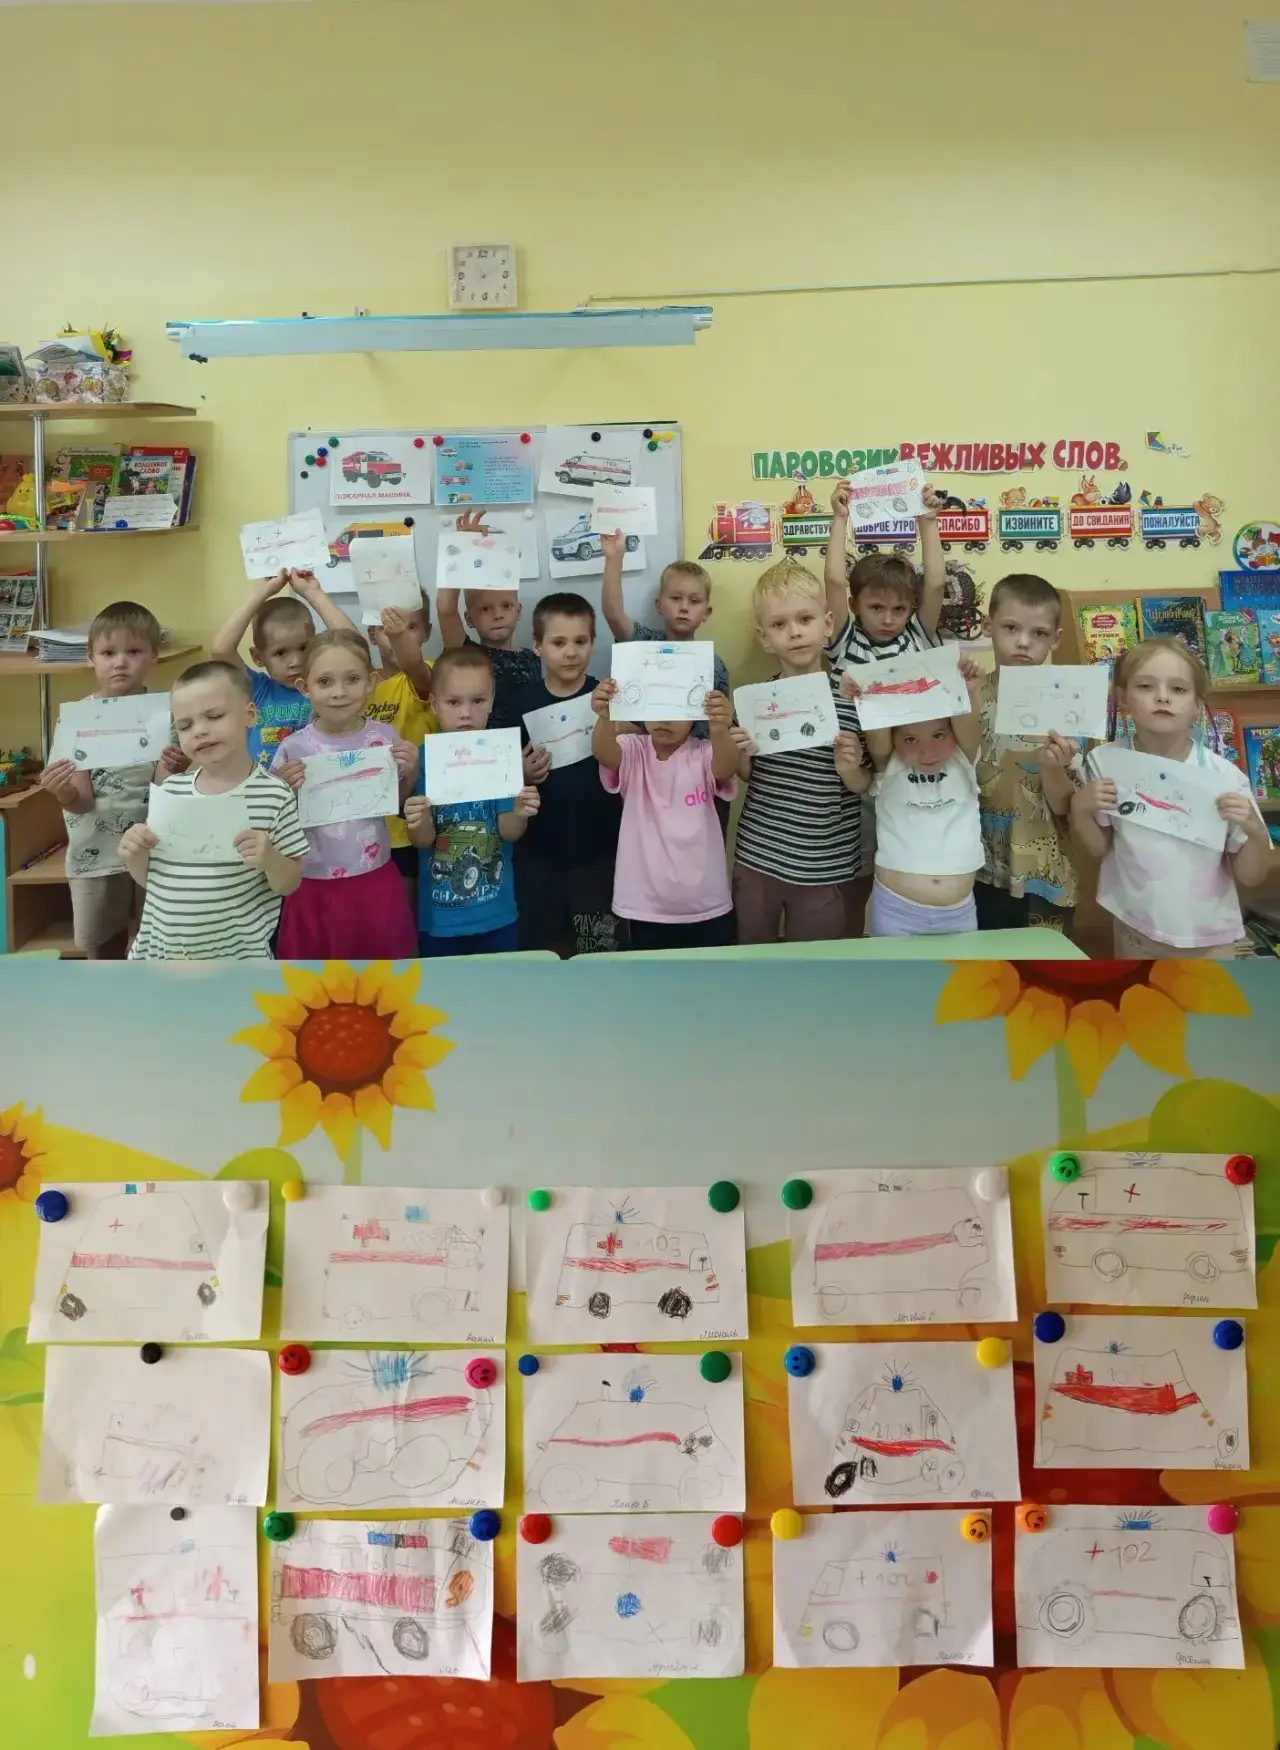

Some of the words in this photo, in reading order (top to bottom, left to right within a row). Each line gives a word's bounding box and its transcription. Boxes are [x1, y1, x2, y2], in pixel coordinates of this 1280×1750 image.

[753, 448, 899, 479] ПАРОВОЗИК
[899, 441, 1047, 472] ВЕЖЛИВЫХ
[1053, 440, 1121, 471] СЛОВ
[893, 520, 915, 533] УТРО
[937, 517, 980, 532] СПАСИБО
[1005, 515, 1055, 531] ИЗВИНИТЕ
[1072, 513, 1084, 527] ДО
[1086, 514, 1130, 526] СВИДАНИЯ
[1143, 514, 1201, 529] ПОЖАЛУЙСТА
[645, 1234, 682, 1258] 103
[1108, 1540, 1159, 1572] 102
